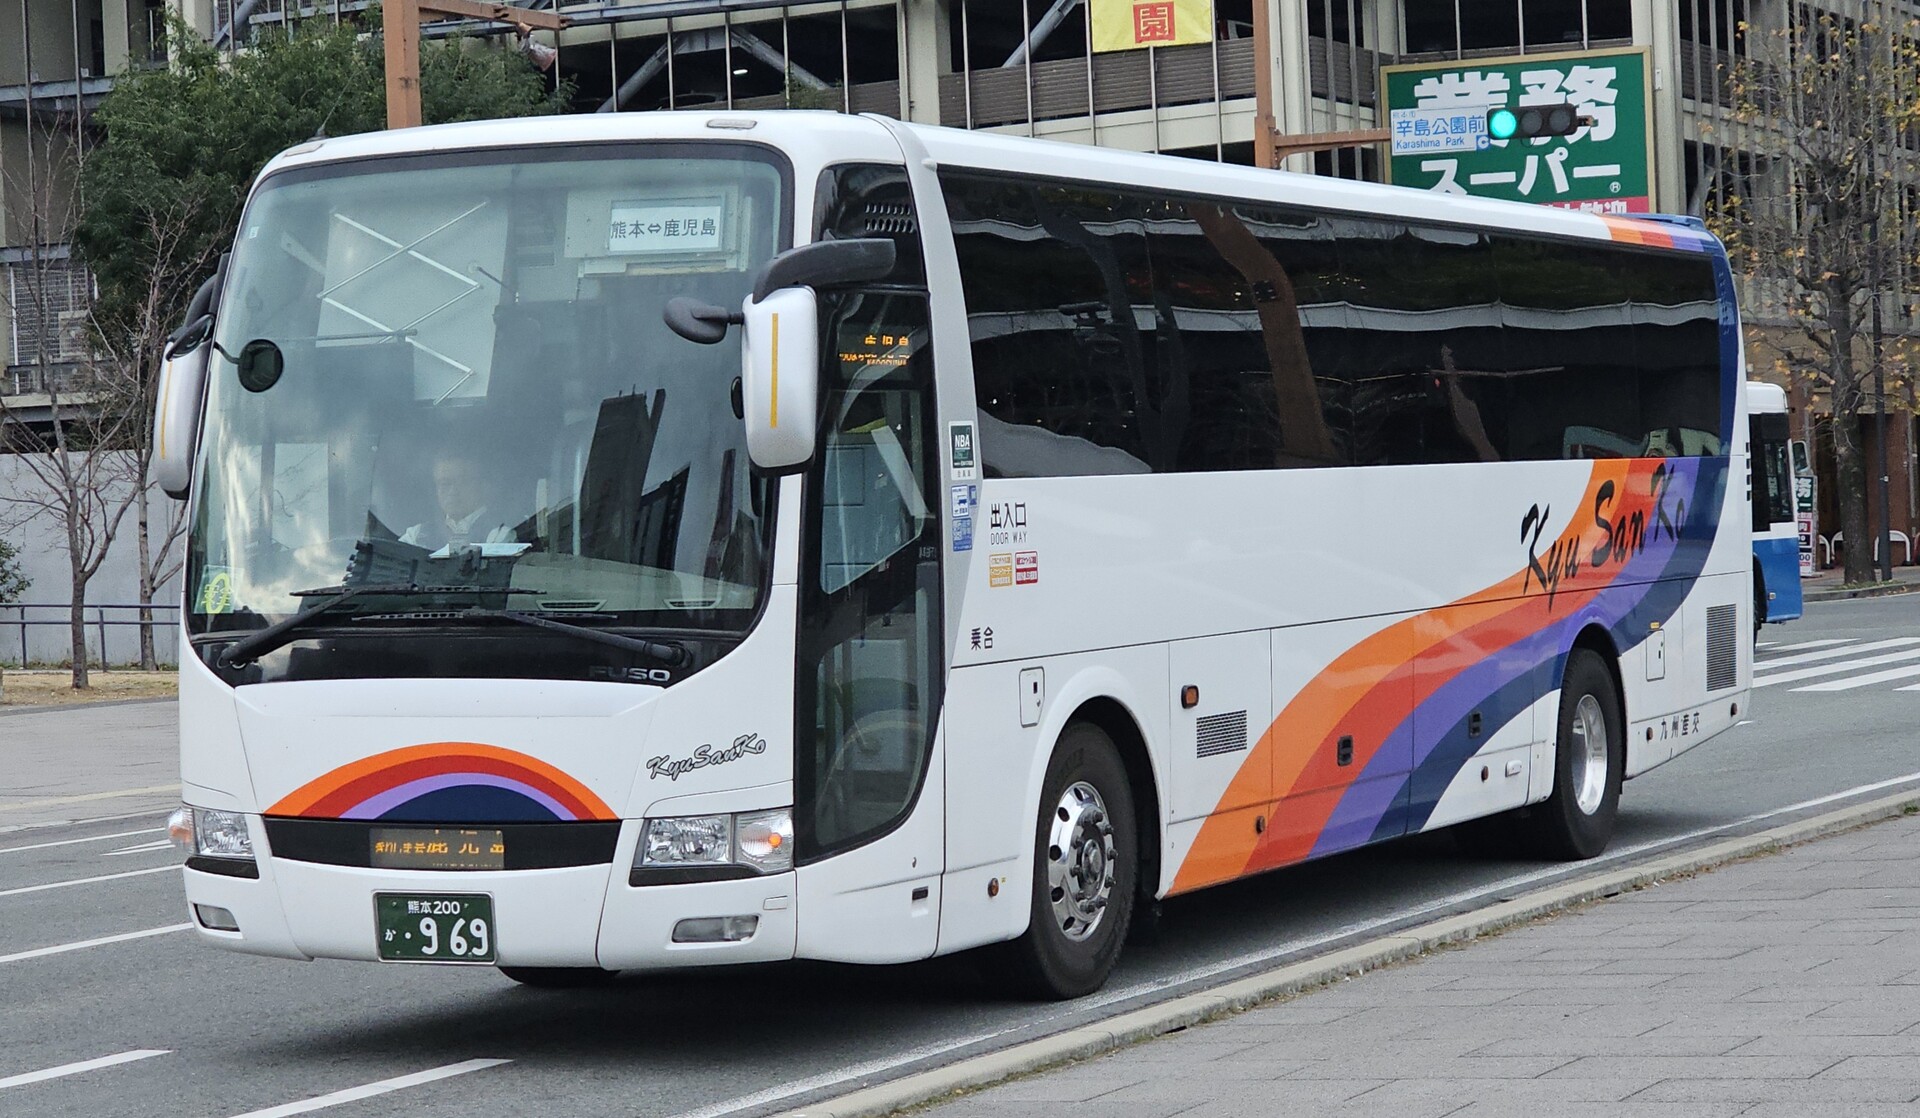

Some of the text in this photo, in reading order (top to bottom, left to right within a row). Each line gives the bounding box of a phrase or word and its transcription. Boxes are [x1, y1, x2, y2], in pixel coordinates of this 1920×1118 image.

[1396, 115, 1485, 137] 辛島公園前
[1396, 136, 1465, 150] Karashima Park
[1421, 147, 1621, 195] スーパー
[611, 217, 717, 239] 熊本 鹿児島
[954, 434, 970, 447] NBA
[990, 502, 1027, 529] 出入口
[990, 531, 1027, 545] DOOR WAY
[1521, 462, 1685, 614] Kyu San Ko
[971, 626, 994, 650] 乗合
[590, 665, 670, 682] FUSO
[646, 733, 766, 781] KyuSanKo
[385, 917, 489, 956] か 969
